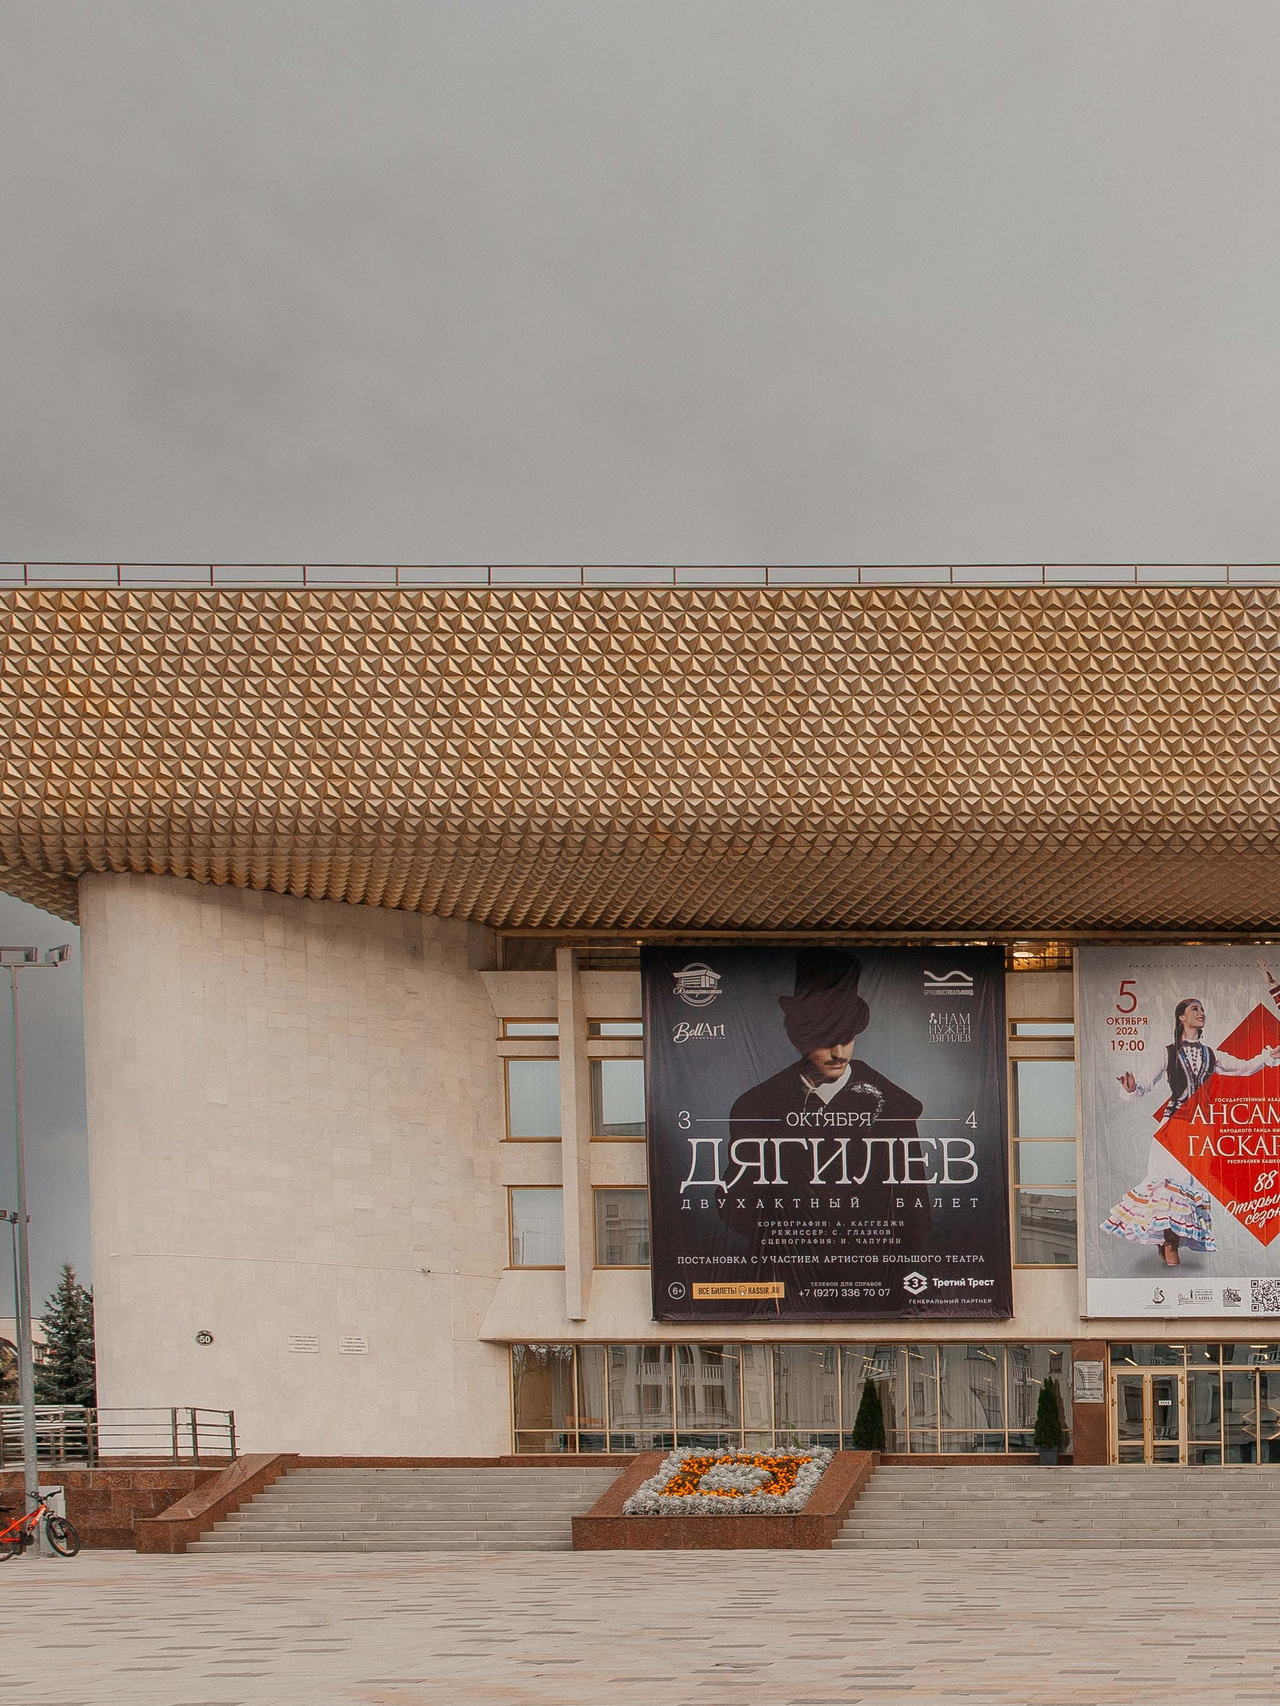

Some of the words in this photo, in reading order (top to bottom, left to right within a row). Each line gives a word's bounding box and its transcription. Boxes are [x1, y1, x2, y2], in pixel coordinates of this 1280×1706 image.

[1115, 980, 1138, 1014] 5
[938, 1013, 971, 1024] НАМ
[1106, 1016, 1148, 1026] ОКТЯБРЯ
[929, 1025, 971, 1034] НУЖЕН
[1116, 1026, 1139, 1036] 2026
[928, 1034, 972, 1043] ДЯГИЛЕВ
[1110, 1040, 1145, 1052] 19:00
[678, 1110, 691, 1130] 3
[786, 1111, 872, 1127] ОКТЯБРЯ
[965, 1110, 978, 1129] 4
[680, 1137, 979, 1194] ДЯГИЛЕВ
[1253, 1169, 1279, 1193] 88
[681, 1197, 860, 1210] ДВУХАКТНЫЙ
[896, 1198, 979, 1208] БАЛЕТ
[761, 1238, 836, 1246] СЦЕНОГРАФИЯ:
[677, 1256, 747, 1265] ПОСТАНОВКА
[751, 1256, 758, 1264] С
[762, 1255, 820, 1264] УЧАСТИЕМ
[823, 1255, 879, 1263] АРТИСТОВ
[882, 1254, 942, 1263] БОЛЬШОГО
[945, 1254, 985, 1263] ТЕАТРА
[932, 1277, 966, 1288] Третий
[967, 1278, 995, 1288] Трест
[672, 1287, 683, 1295] 6+
[698, 1287, 710, 1295] ВСЕ
[711, 1286, 737, 1295] БИЛЕТЫ
[798, 1289, 810, 1297] +7
[813, 1288, 839, 1298] (927)
[841, 1288, 861, 1297] 336
[864, 1288, 876, 1297] 70
[878, 1288, 891, 1297] 07
[200, 1335, 210, 1343] 50
